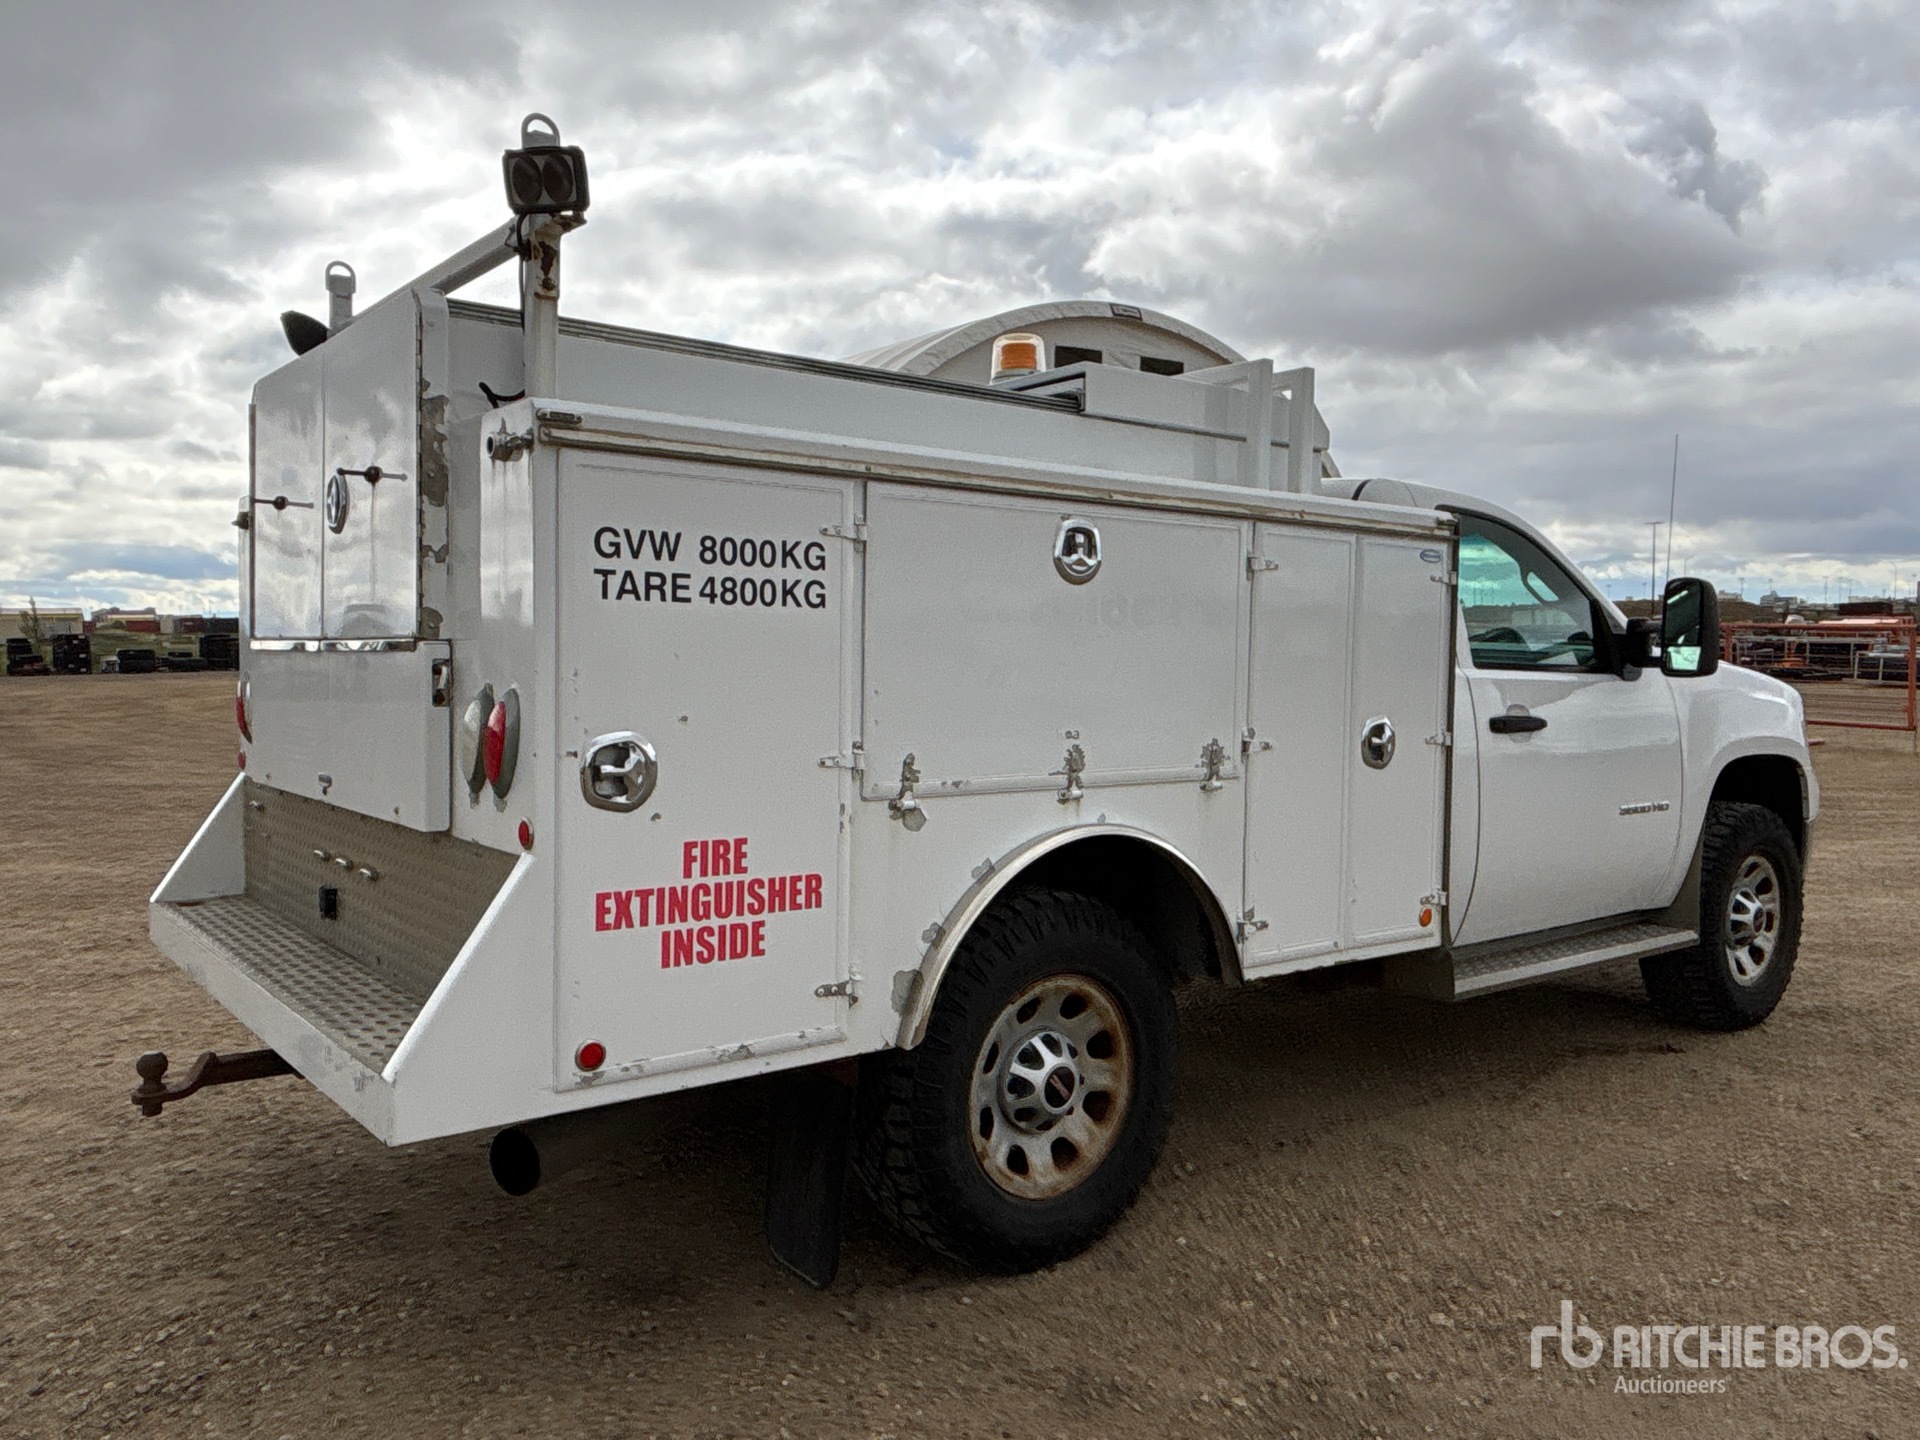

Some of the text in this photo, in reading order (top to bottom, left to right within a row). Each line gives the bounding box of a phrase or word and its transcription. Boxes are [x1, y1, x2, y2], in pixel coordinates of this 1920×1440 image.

[594, 526, 826, 571] GVW 8000KG
[594, 568, 826, 608] TARE 4800KG
[683, 837, 748, 879] FIRE
[595, 873, 822, 932] EXTINGUISHER
[661, 920, 766, 969] INSIDE
